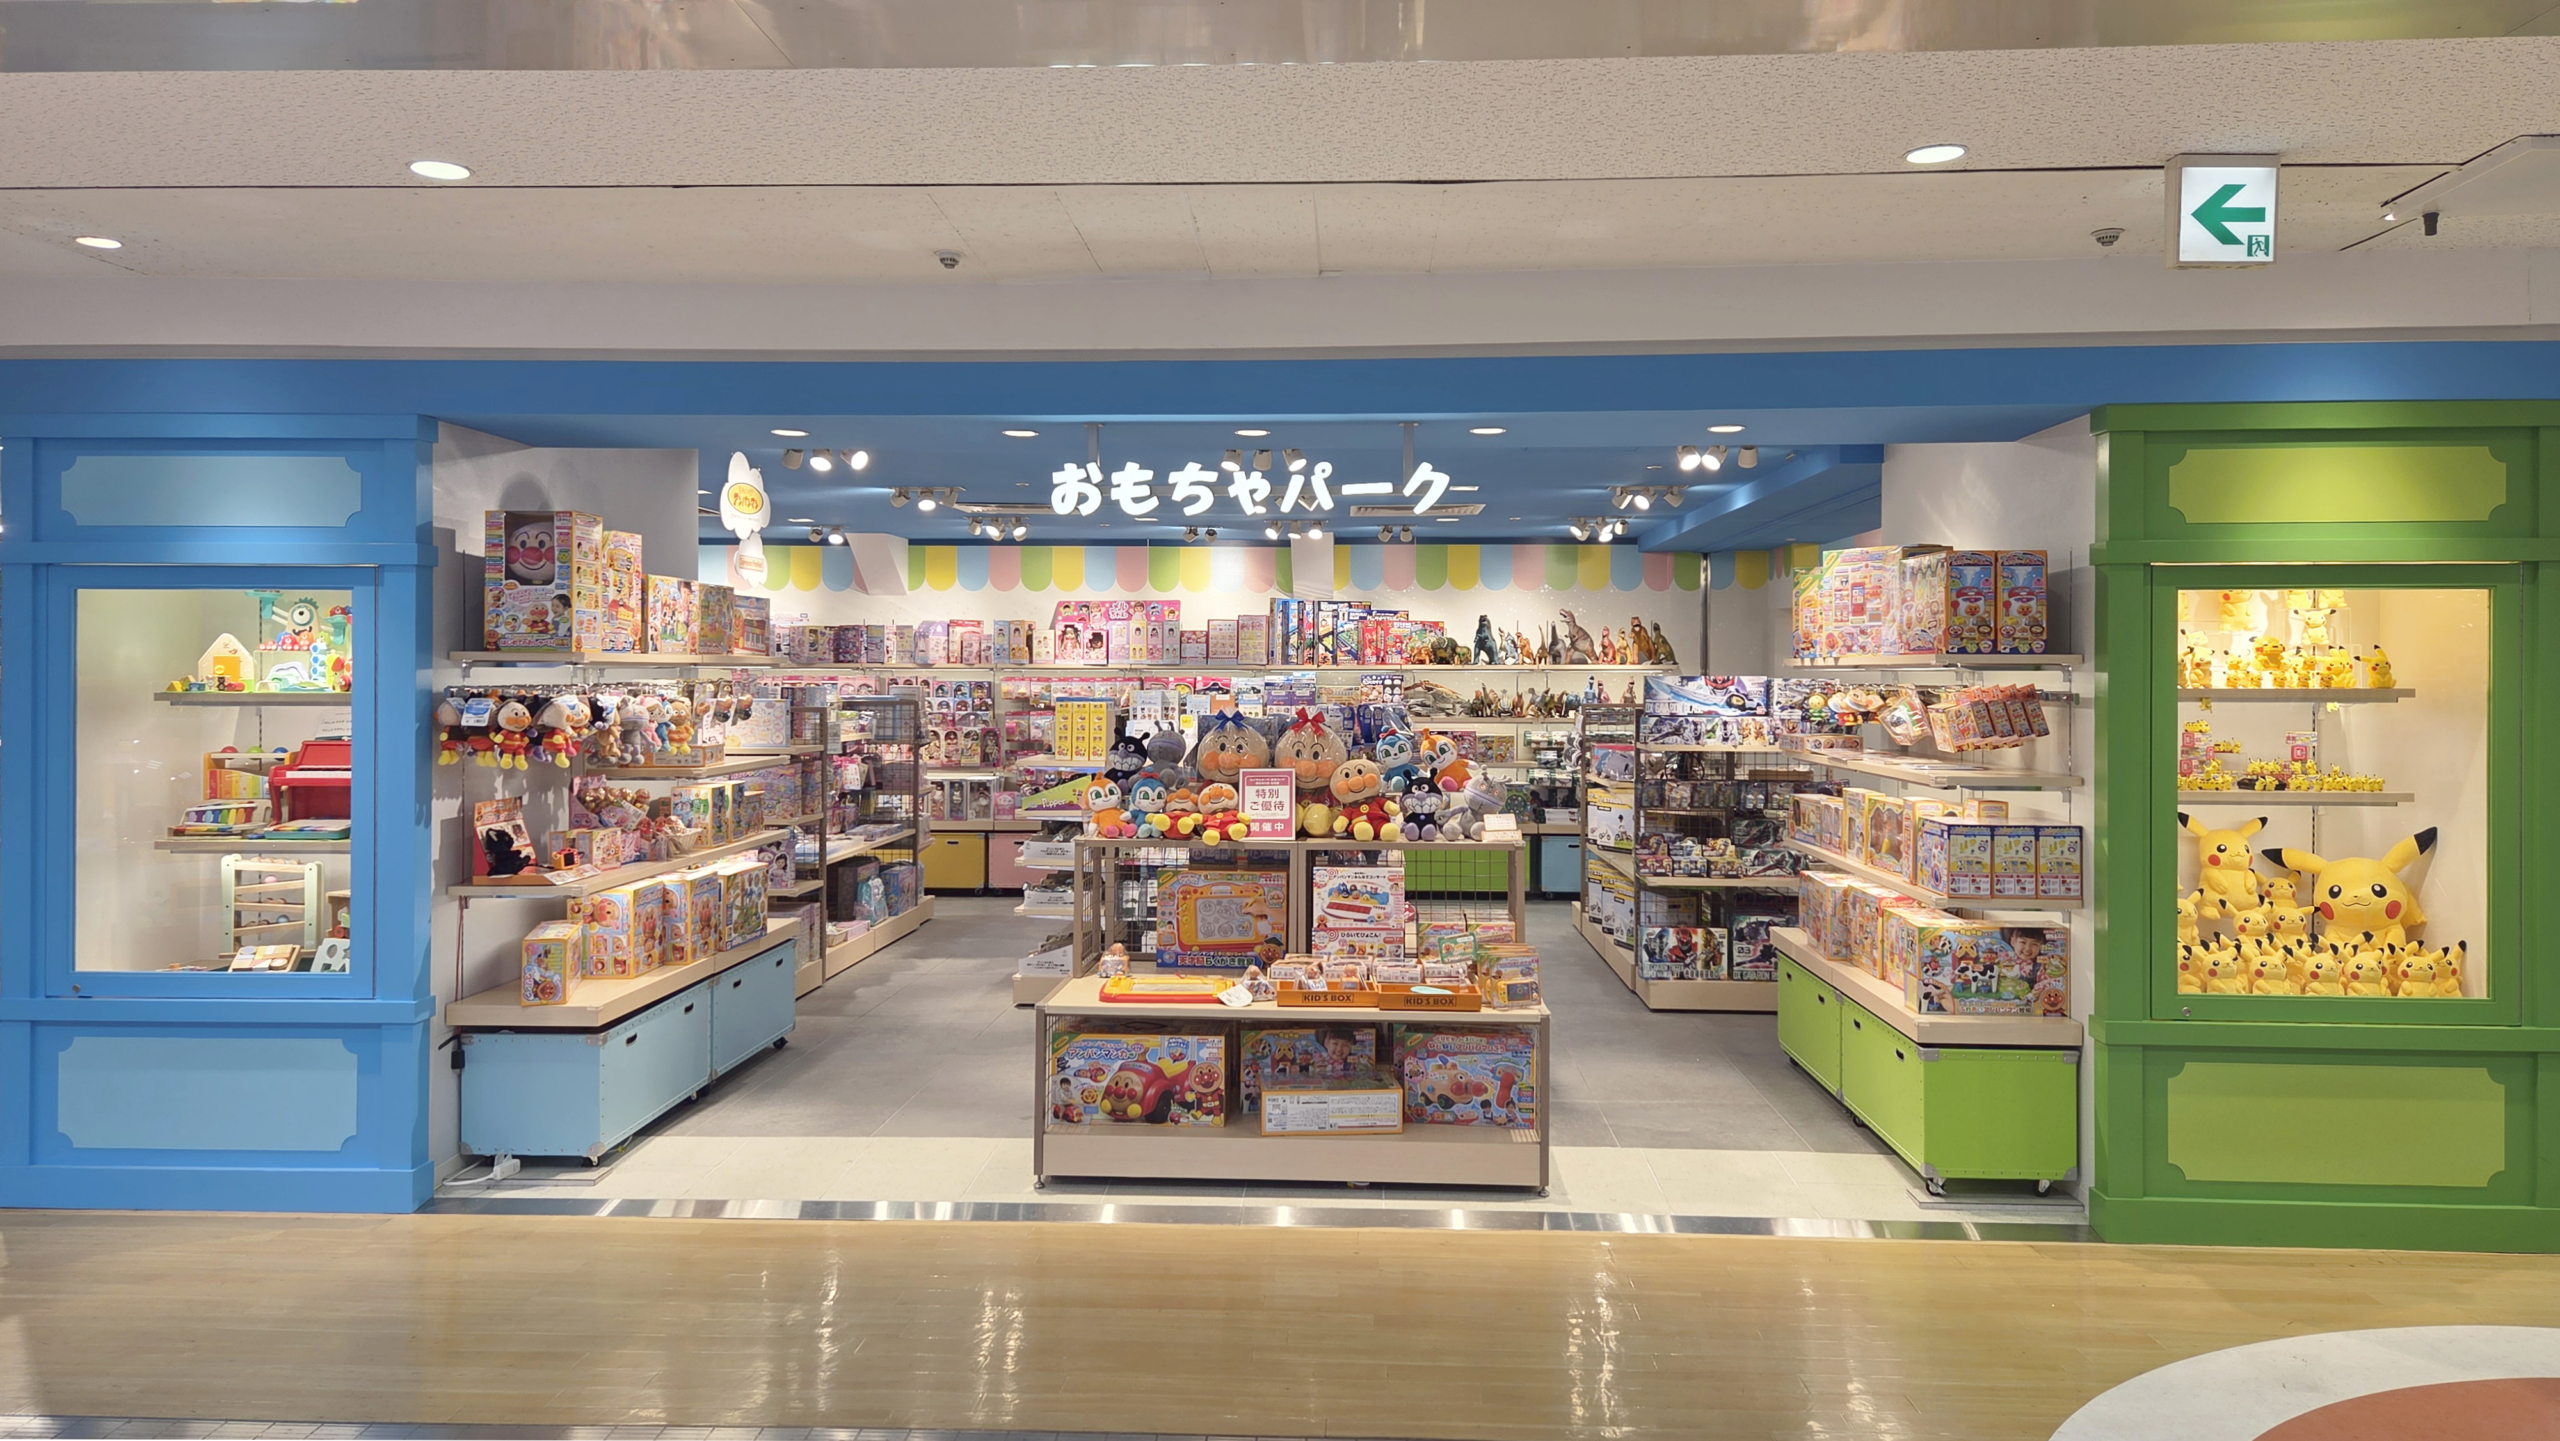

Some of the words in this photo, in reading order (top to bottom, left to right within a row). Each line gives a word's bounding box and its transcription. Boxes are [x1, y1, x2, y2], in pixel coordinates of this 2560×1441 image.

[1051, 461, 1450, 516] おもちゃパーク
[1255, 788, 1279, 799] 特別
[1250, 801, 1285, 811] ご優待
[1250, 822, 1284, 832] 開催中
[1331, 994, 1352, 1002] BOX
[1433, 997, 1454, 1005] BOX
[1069, 1047, 1134, 1059] アンパンマンカー
